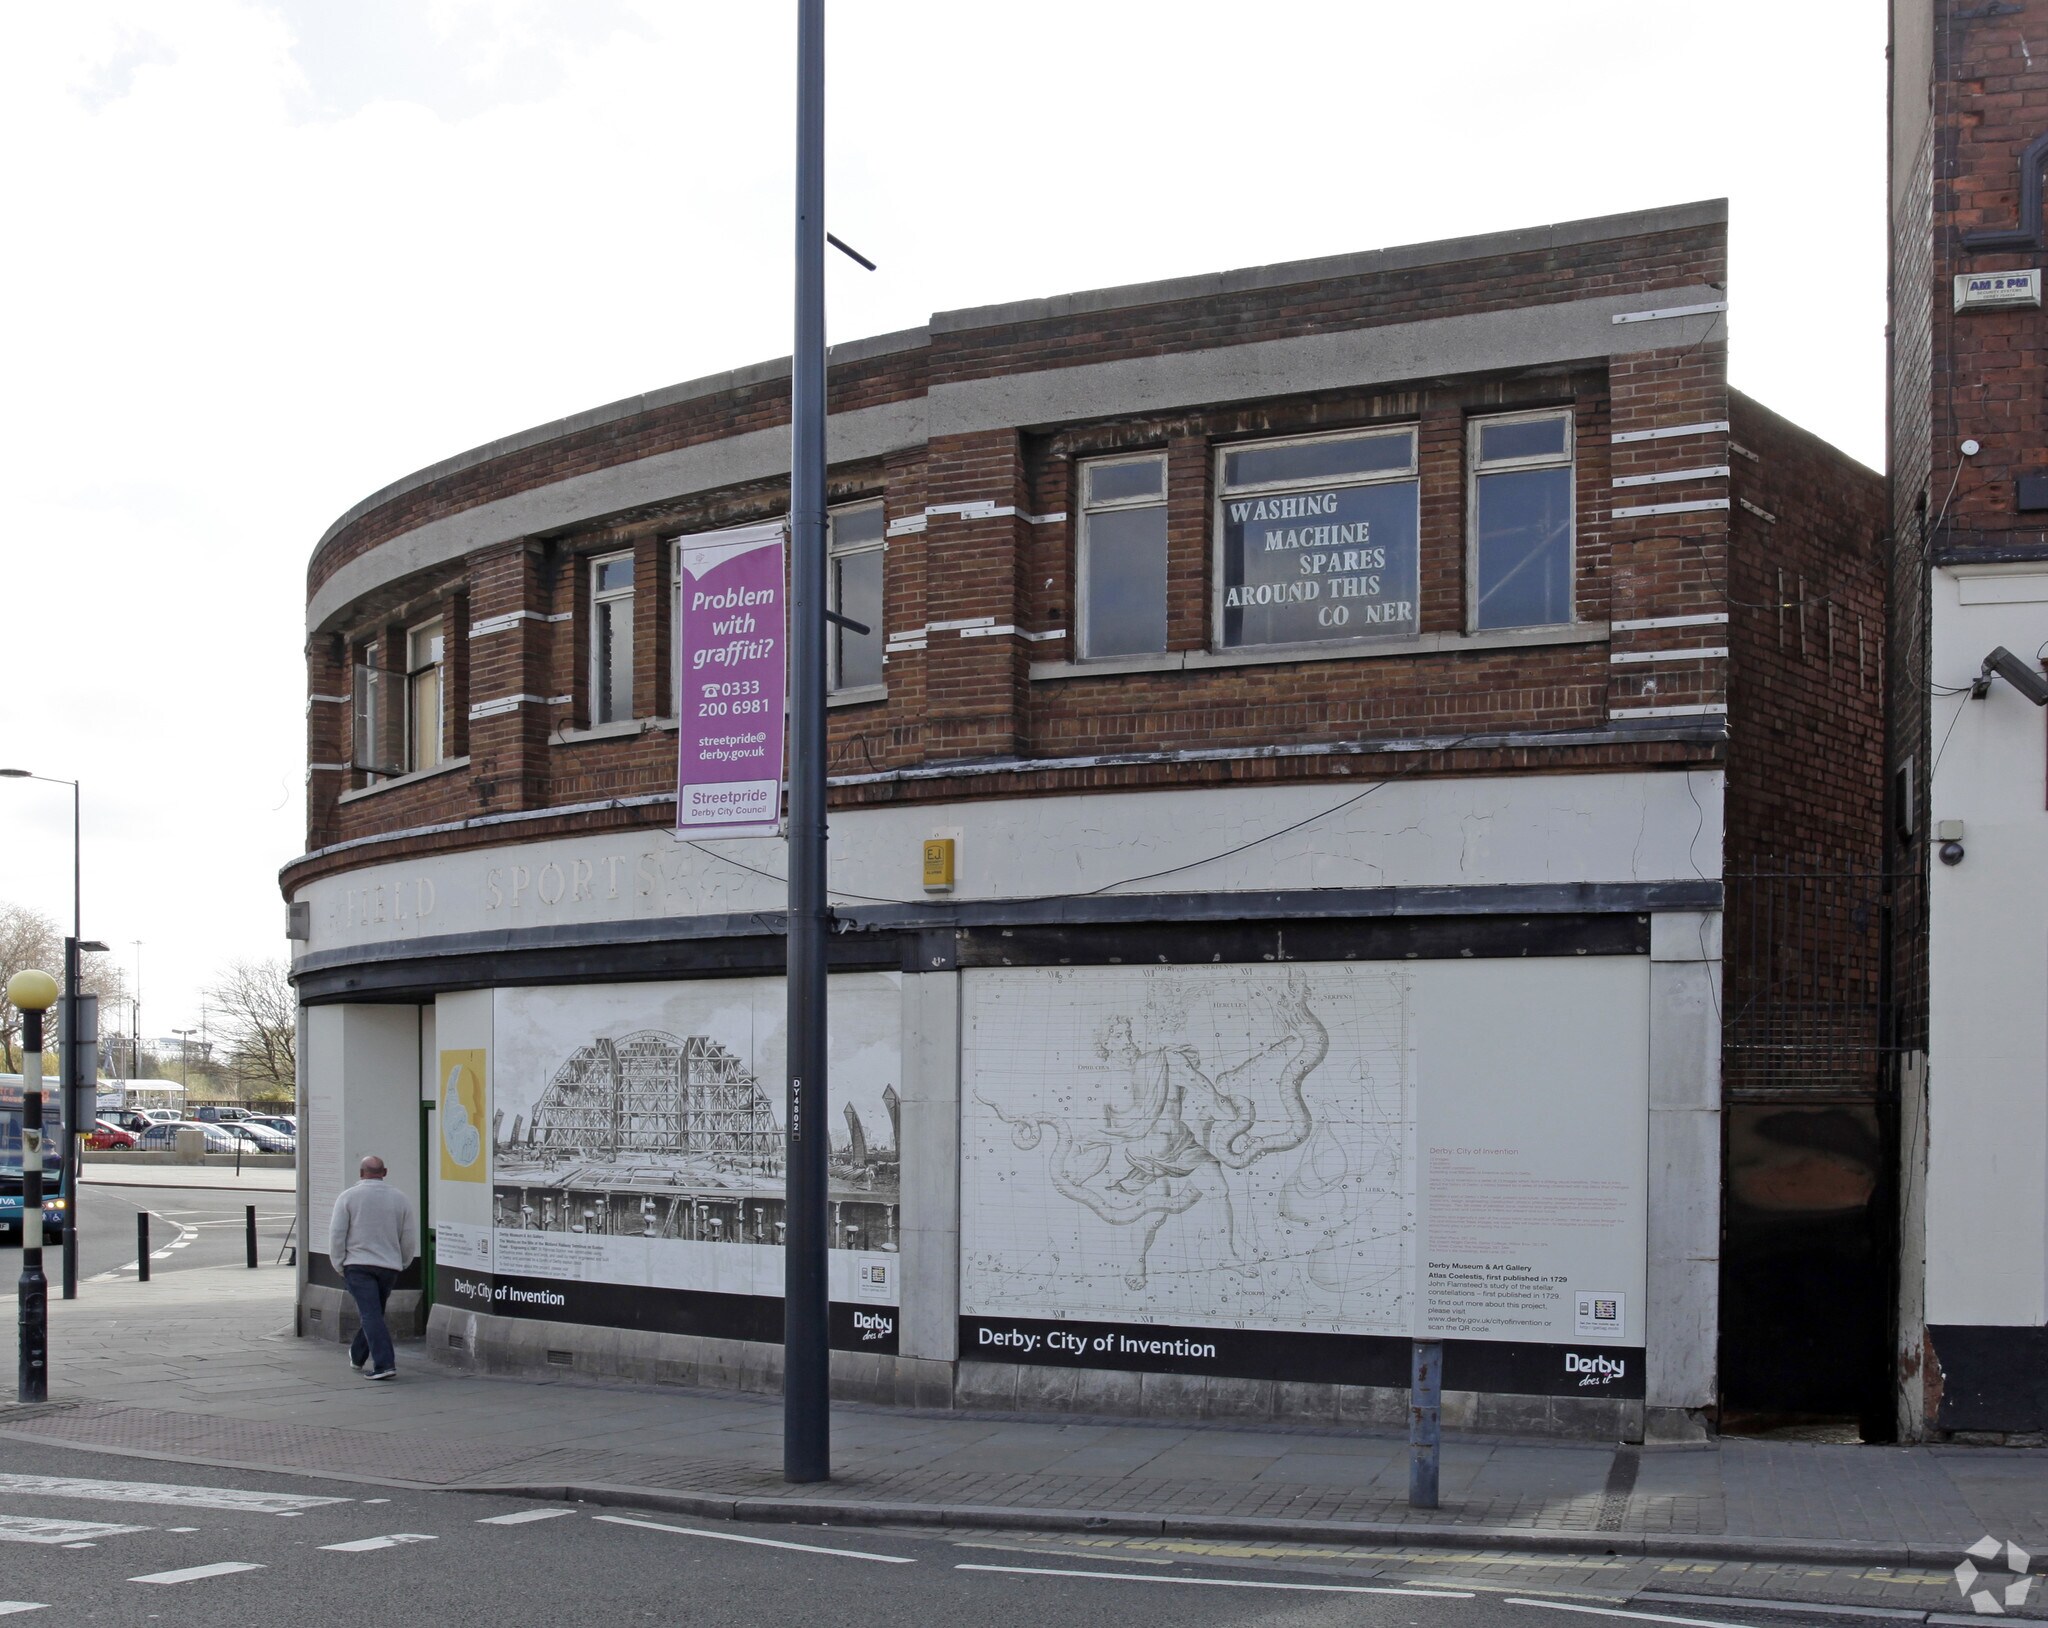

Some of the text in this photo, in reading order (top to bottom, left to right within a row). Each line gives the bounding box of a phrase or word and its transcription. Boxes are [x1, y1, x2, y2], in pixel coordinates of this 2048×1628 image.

[1970, 278, 2028, 291] AM 2 PM
[1230, 493, 1338, 523] WASHING
[1265, 522, 1369, 551] MACHINE
[1300, 547, 1385, 575] SPARES
[691, 586, 774, 611] Problem
[1226, 575, 1380, 607] AROUND THIS
[712, 613, 756, 636] with
[693, 639, 774, 670] graffiti?
[722, 680, 760, 697] 0333
[698, 699, 769, 717] 200 6981
[699, 732, 766, 747] streetpride@
[699, 747, 765, 762] derby.gov.uk
[693, 790, 767, 806] Streetpride
[691, 805, 767, 818] Derby City Council
[346, 852, 656, 927] FIELD SPORTS
[793, 1079, 801, 1131] DY4802
[1457, 1148, 1472, 1156] City
[1429, 1262, 1451, 1270] Derby
[1505, 1264, 1532, 1272] Gallery
[1448, 1273, 1485, 1281] Coelestis,
[454, 1279, 565, 1306] Derby: City of Invention
[1447, 1281, 1488, 1289] Flamsteed's
[1489, 1283, 1509, 1291] study
[854, 1312, 893, 1334] Derby
[979, 1328, 1216, 1358] Derby: City of Invention
[1565, 1353, 1625, 1378] Derby
